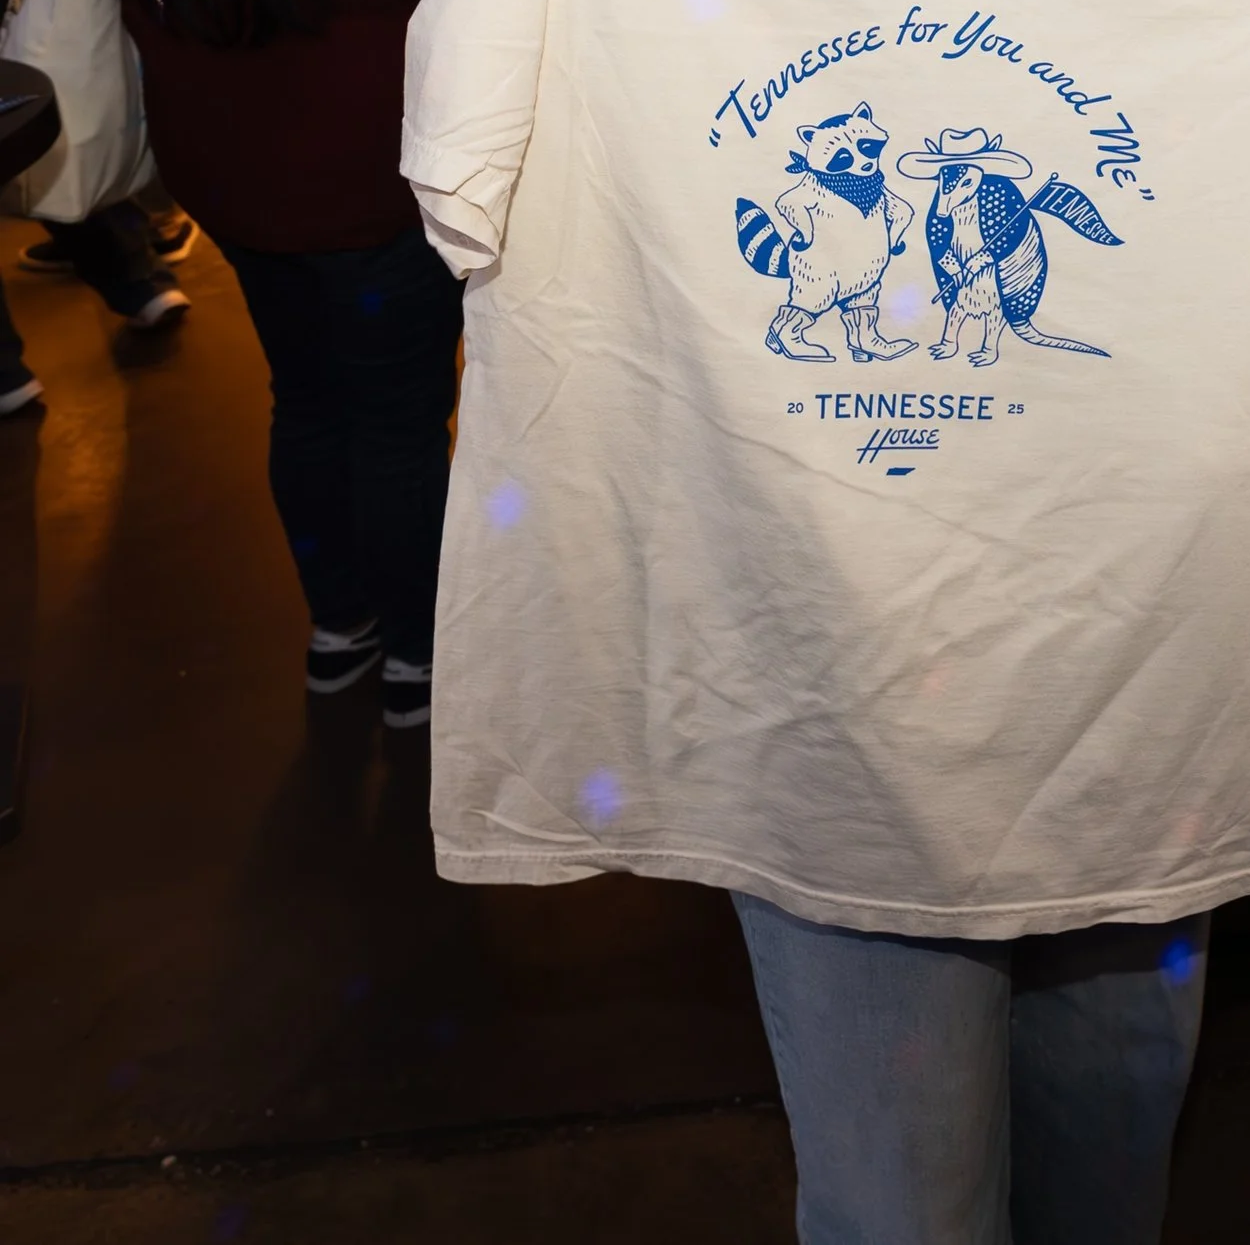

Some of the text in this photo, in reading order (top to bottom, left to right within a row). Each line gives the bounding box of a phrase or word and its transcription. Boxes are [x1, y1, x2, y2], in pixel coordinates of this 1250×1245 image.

[896, 5, 948, 46] for
[941, 11, 1024, 64] You
[1028, 61, 1113, 116] and
[1039, 184, 1114, 244] TENNESSEE
[786, 393, 1026, 420] 20 TENNESSEE 25
